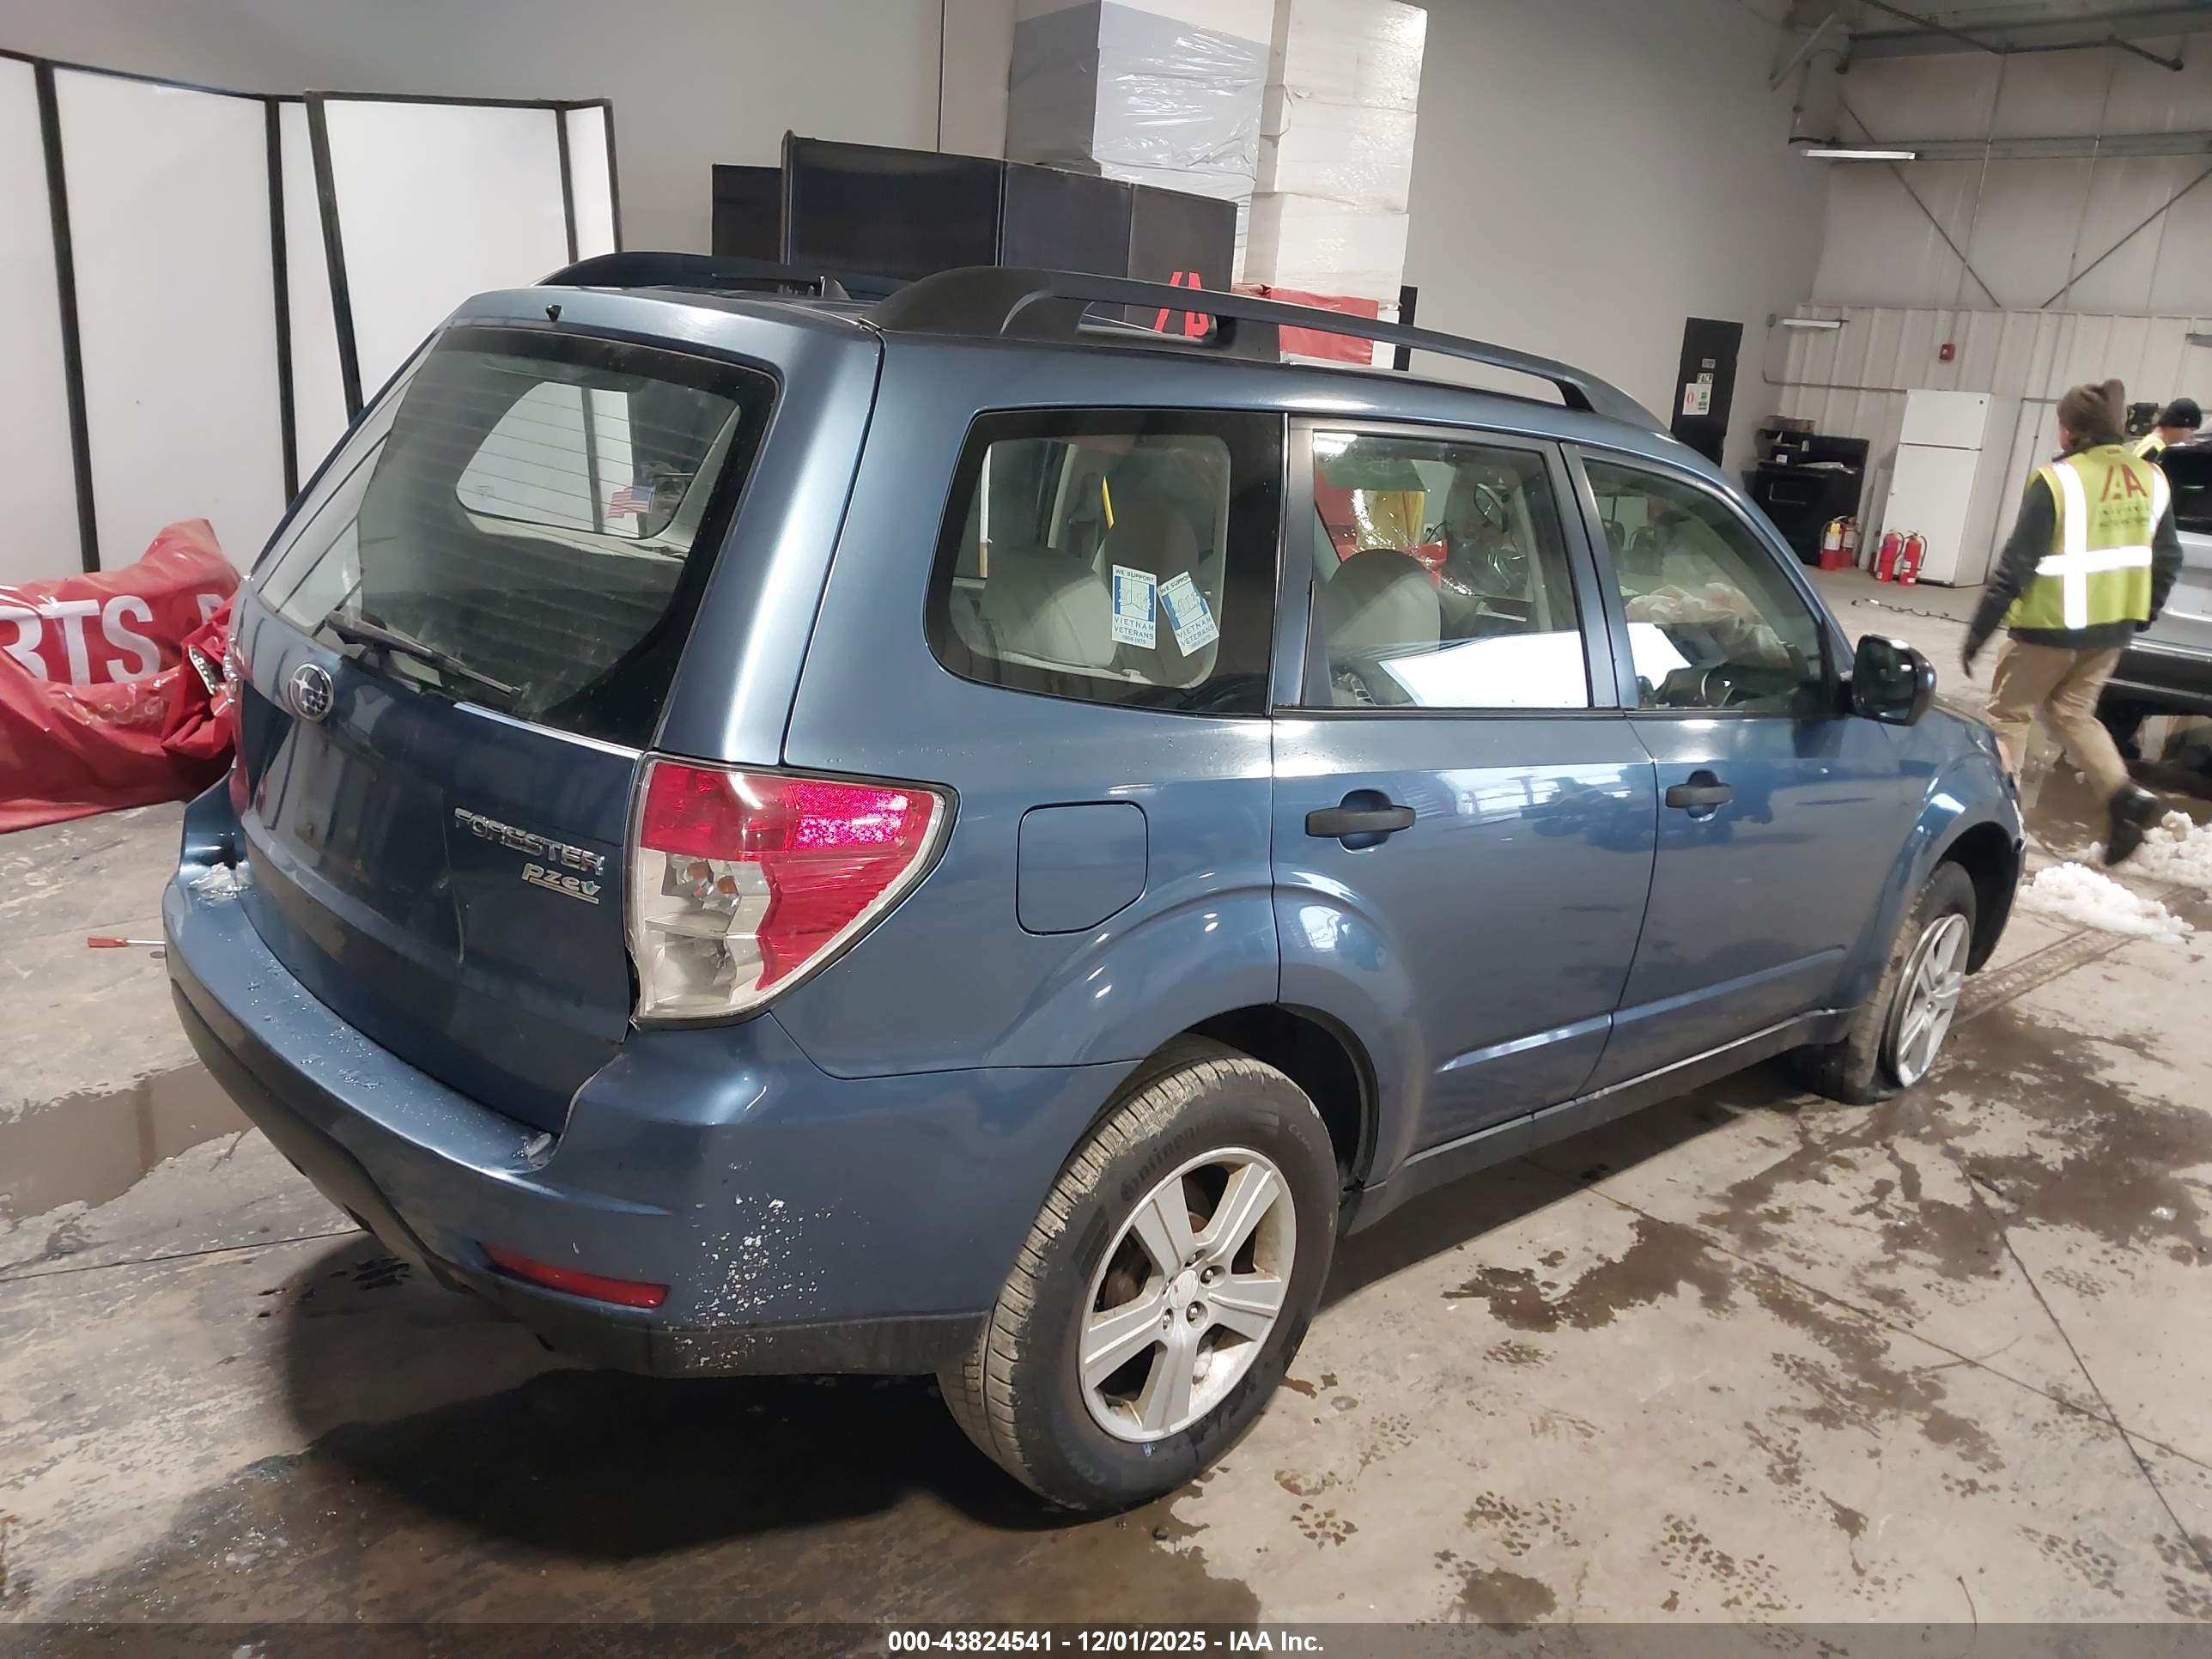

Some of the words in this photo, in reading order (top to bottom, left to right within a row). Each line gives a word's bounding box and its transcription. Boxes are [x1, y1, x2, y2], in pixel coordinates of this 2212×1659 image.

[1127, 570, 1155, 581] SUPPORT
[1159, 584, 1170, 593] WE
[1114, 616, 1154, 630] VIETNAM
[1176, 616, 1211, 639] VIETNAM
[1114, 626, 1154, 640] VETERANS
[1180, 623, 1215, 646] VETERANS
[454, 807, 605, 876] FORESTER
